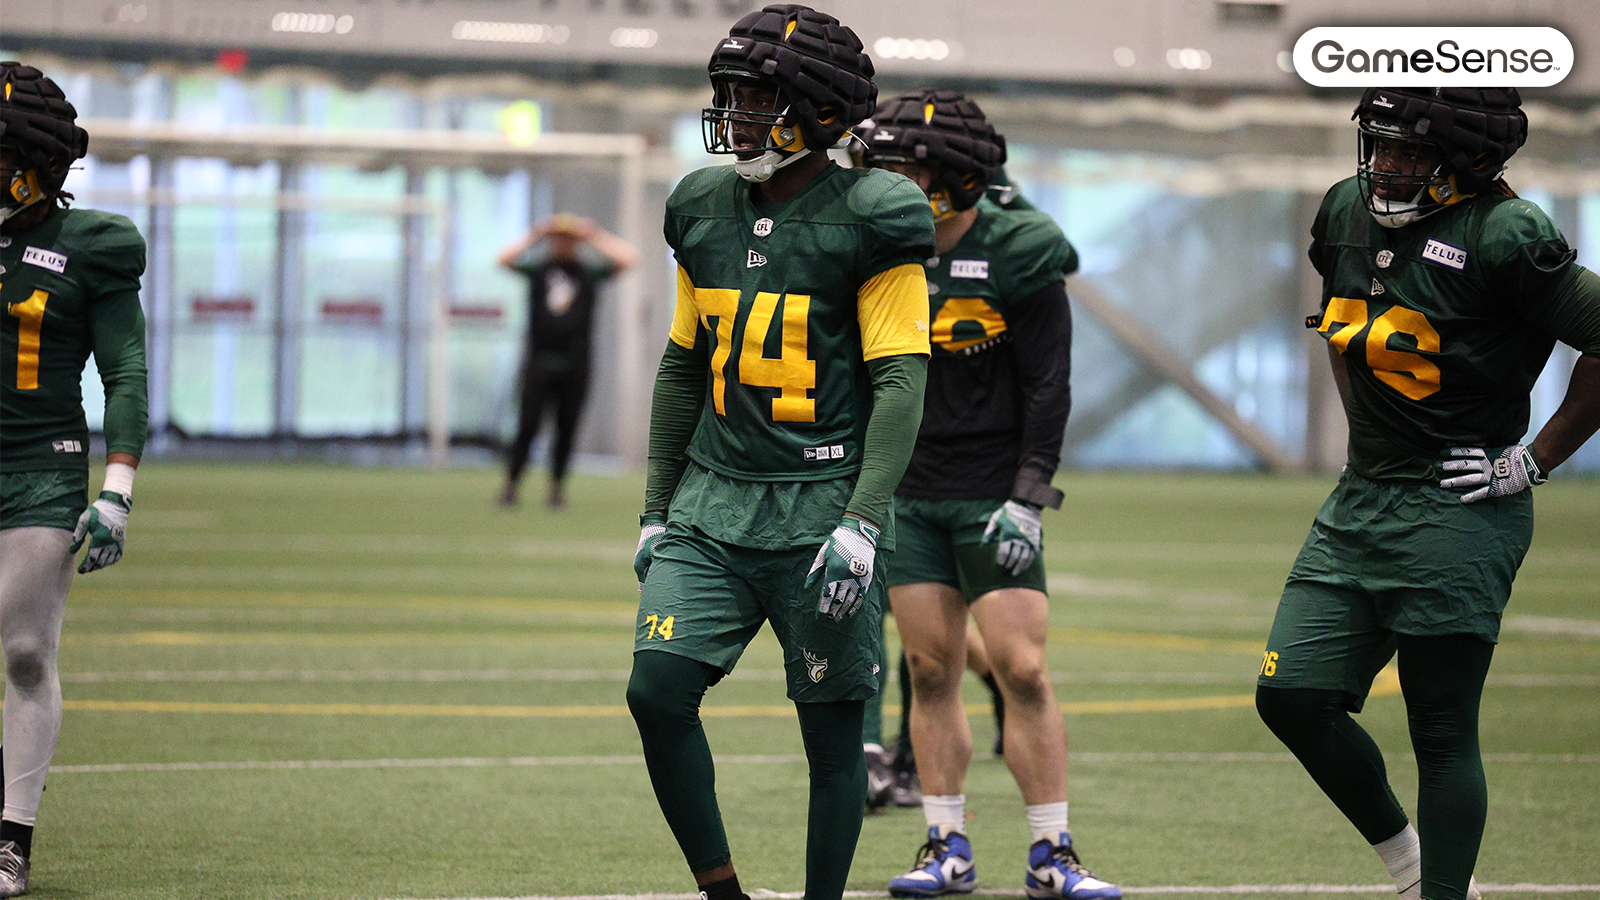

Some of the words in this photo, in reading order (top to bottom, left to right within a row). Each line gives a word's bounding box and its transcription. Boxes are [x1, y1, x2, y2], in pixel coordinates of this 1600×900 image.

[26, 250, 65, 268] TELUS
[1426, 243, 1466, 265] TELUS
[0, 282, 50, 390] 1
[1316, 296, 1442, 401] 76
[694, 286, 817, 423] 74
[831, 446, 844, 457] XL
[645, 614, 675, 641] 74
